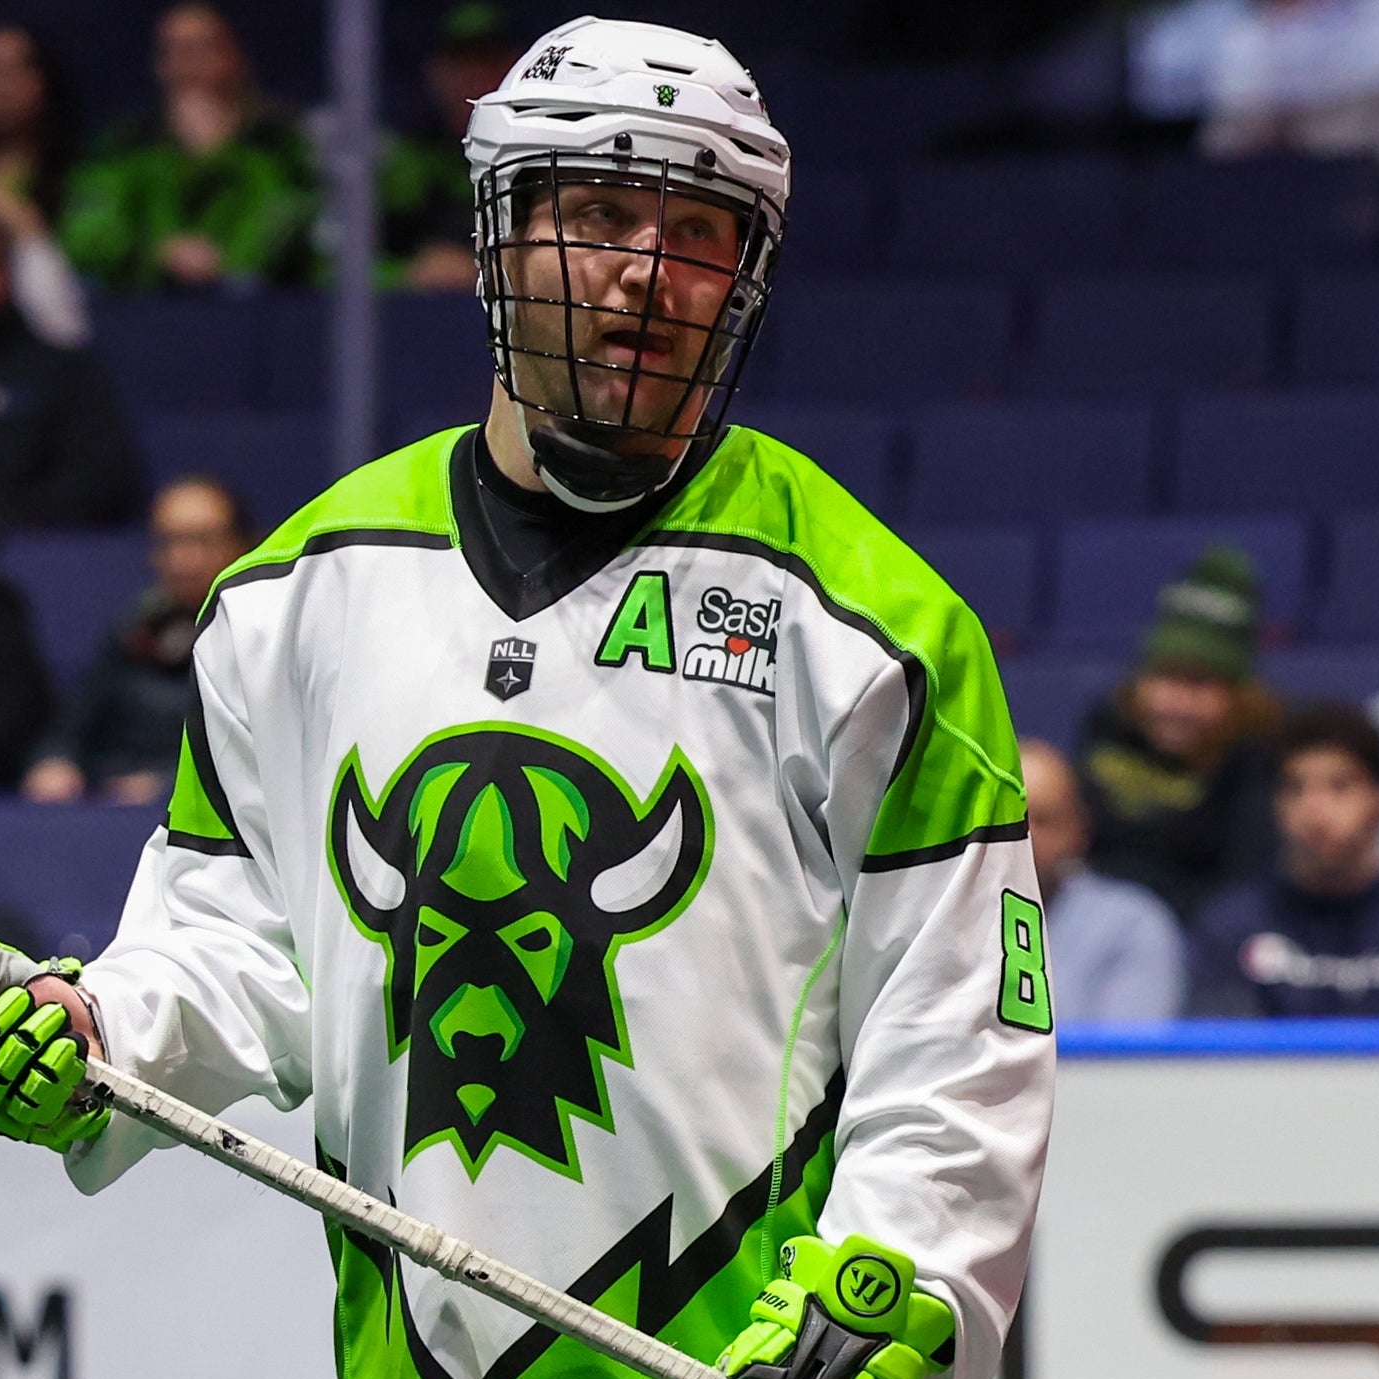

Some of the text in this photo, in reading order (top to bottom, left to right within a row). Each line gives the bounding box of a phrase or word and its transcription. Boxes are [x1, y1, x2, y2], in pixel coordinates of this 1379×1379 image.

[493, 640, 535, 659] NLL
[595, 570, 677, 675] A
[997, 887, 1053, 1035] 8
